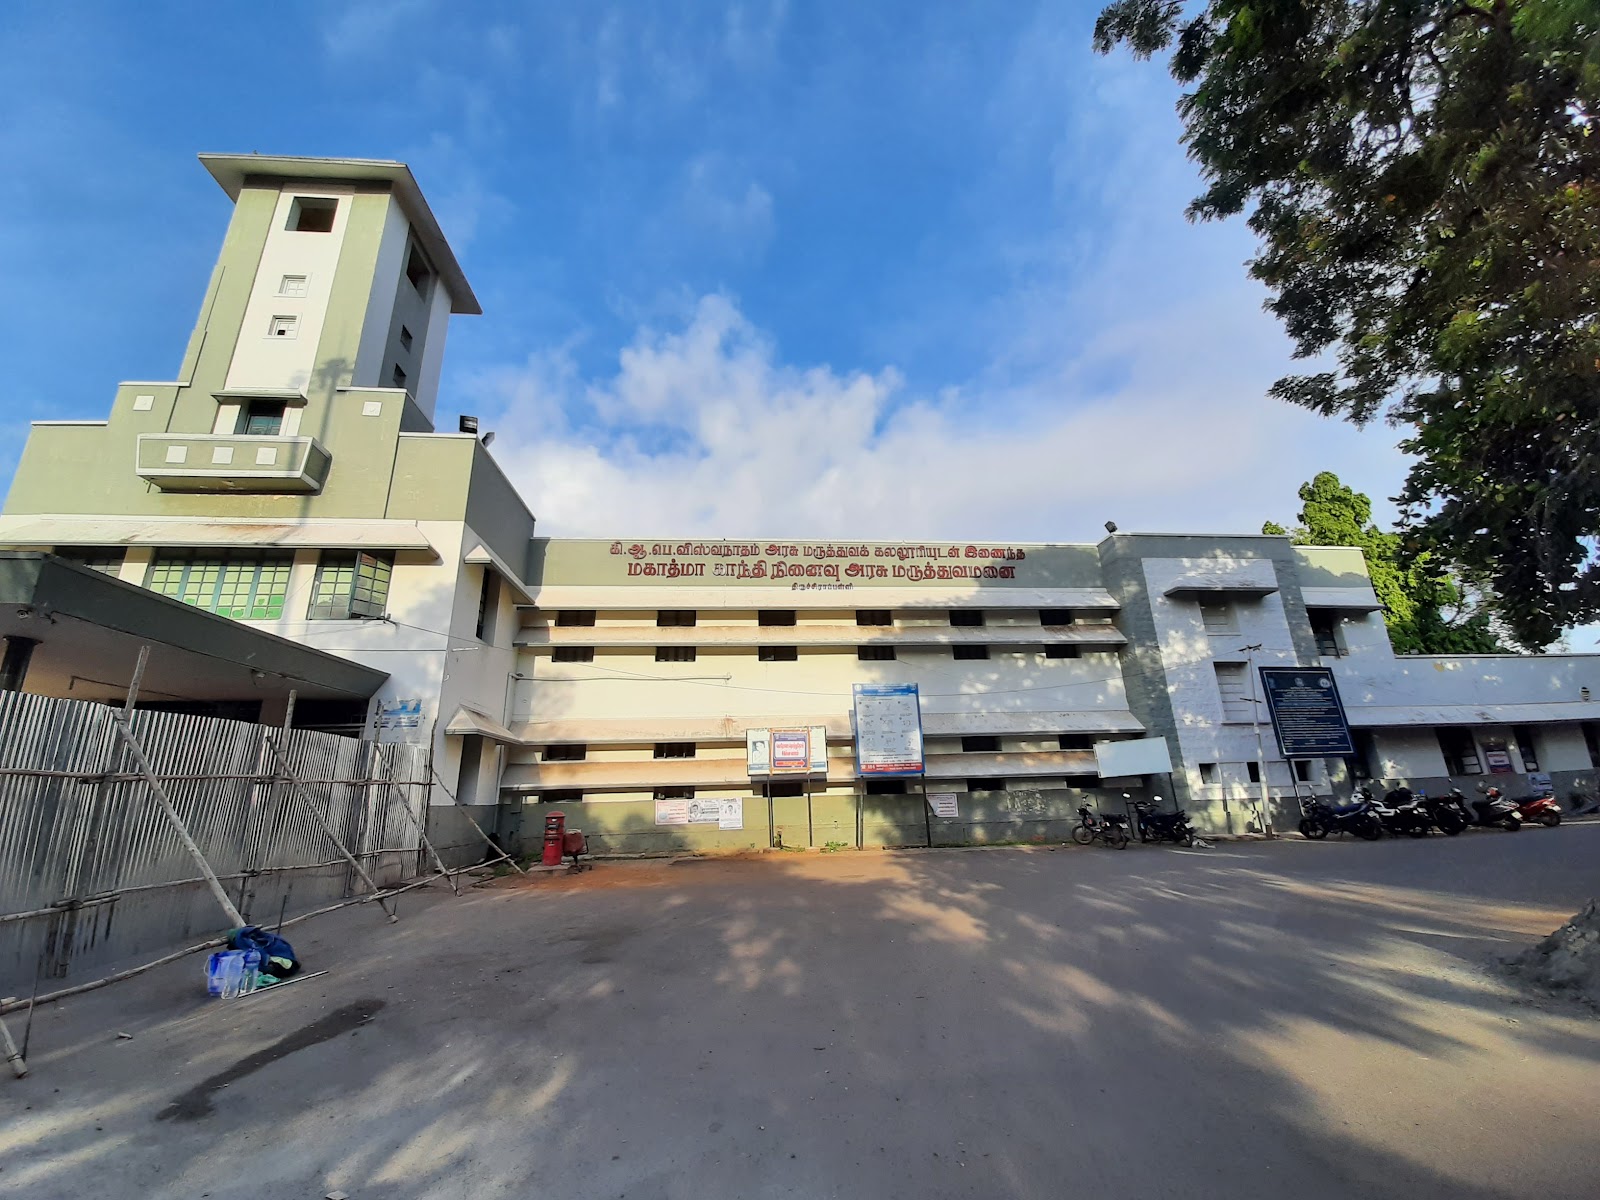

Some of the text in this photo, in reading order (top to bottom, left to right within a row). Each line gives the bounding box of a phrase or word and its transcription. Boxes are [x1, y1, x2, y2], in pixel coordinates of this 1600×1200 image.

[765, 544, 799, 558] அரசு
[803, 544, 870, 559] மருத்துவக்
[964, 545, 1026, 560] இணைந்த
[627, 559, 1016, 581] மகாத்மா காந்தி நினைவு அரசு மருத்துவமனை
